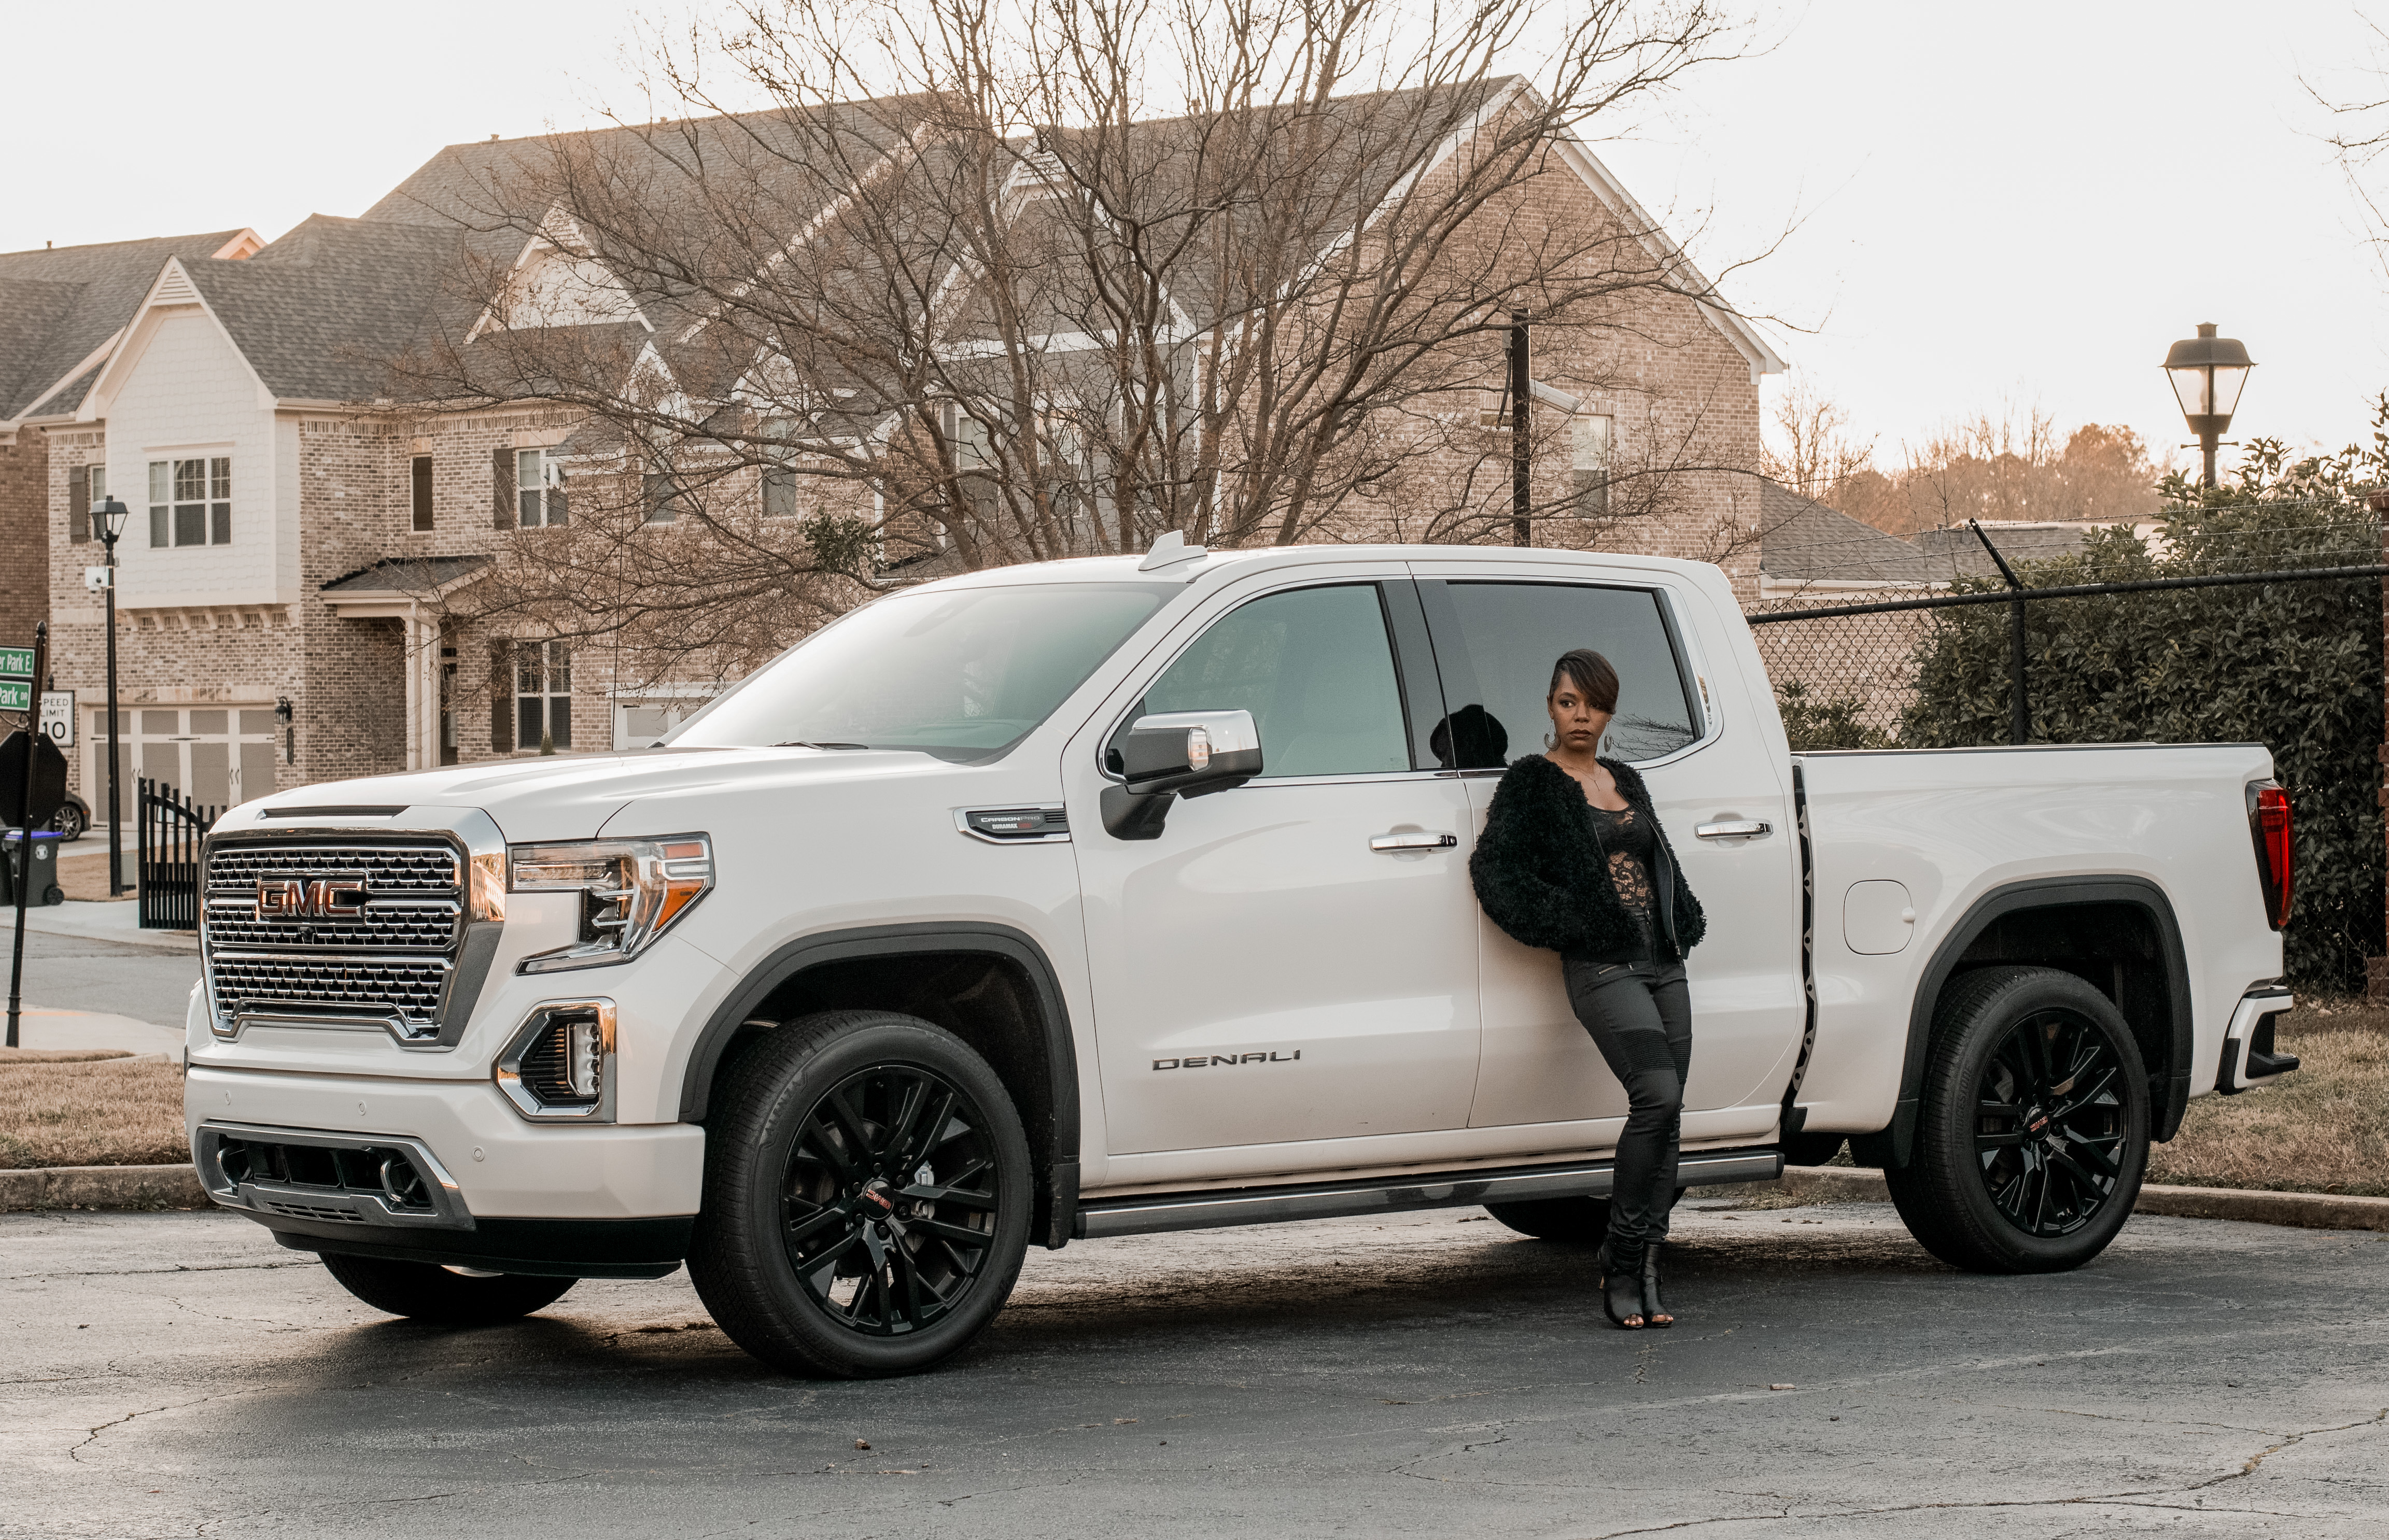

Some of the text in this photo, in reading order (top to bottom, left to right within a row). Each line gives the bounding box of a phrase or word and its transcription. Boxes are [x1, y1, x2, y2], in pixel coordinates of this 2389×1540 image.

[7, 653, 23, 671] Park
[20, 691, 28, 700] DR
[43, 721, 66, 739] 10
[259, 880, 363, 917] GMC
[1152, 1049, 1301, 1070] DENALI
[866, 1189, 891, 1210] GMC
